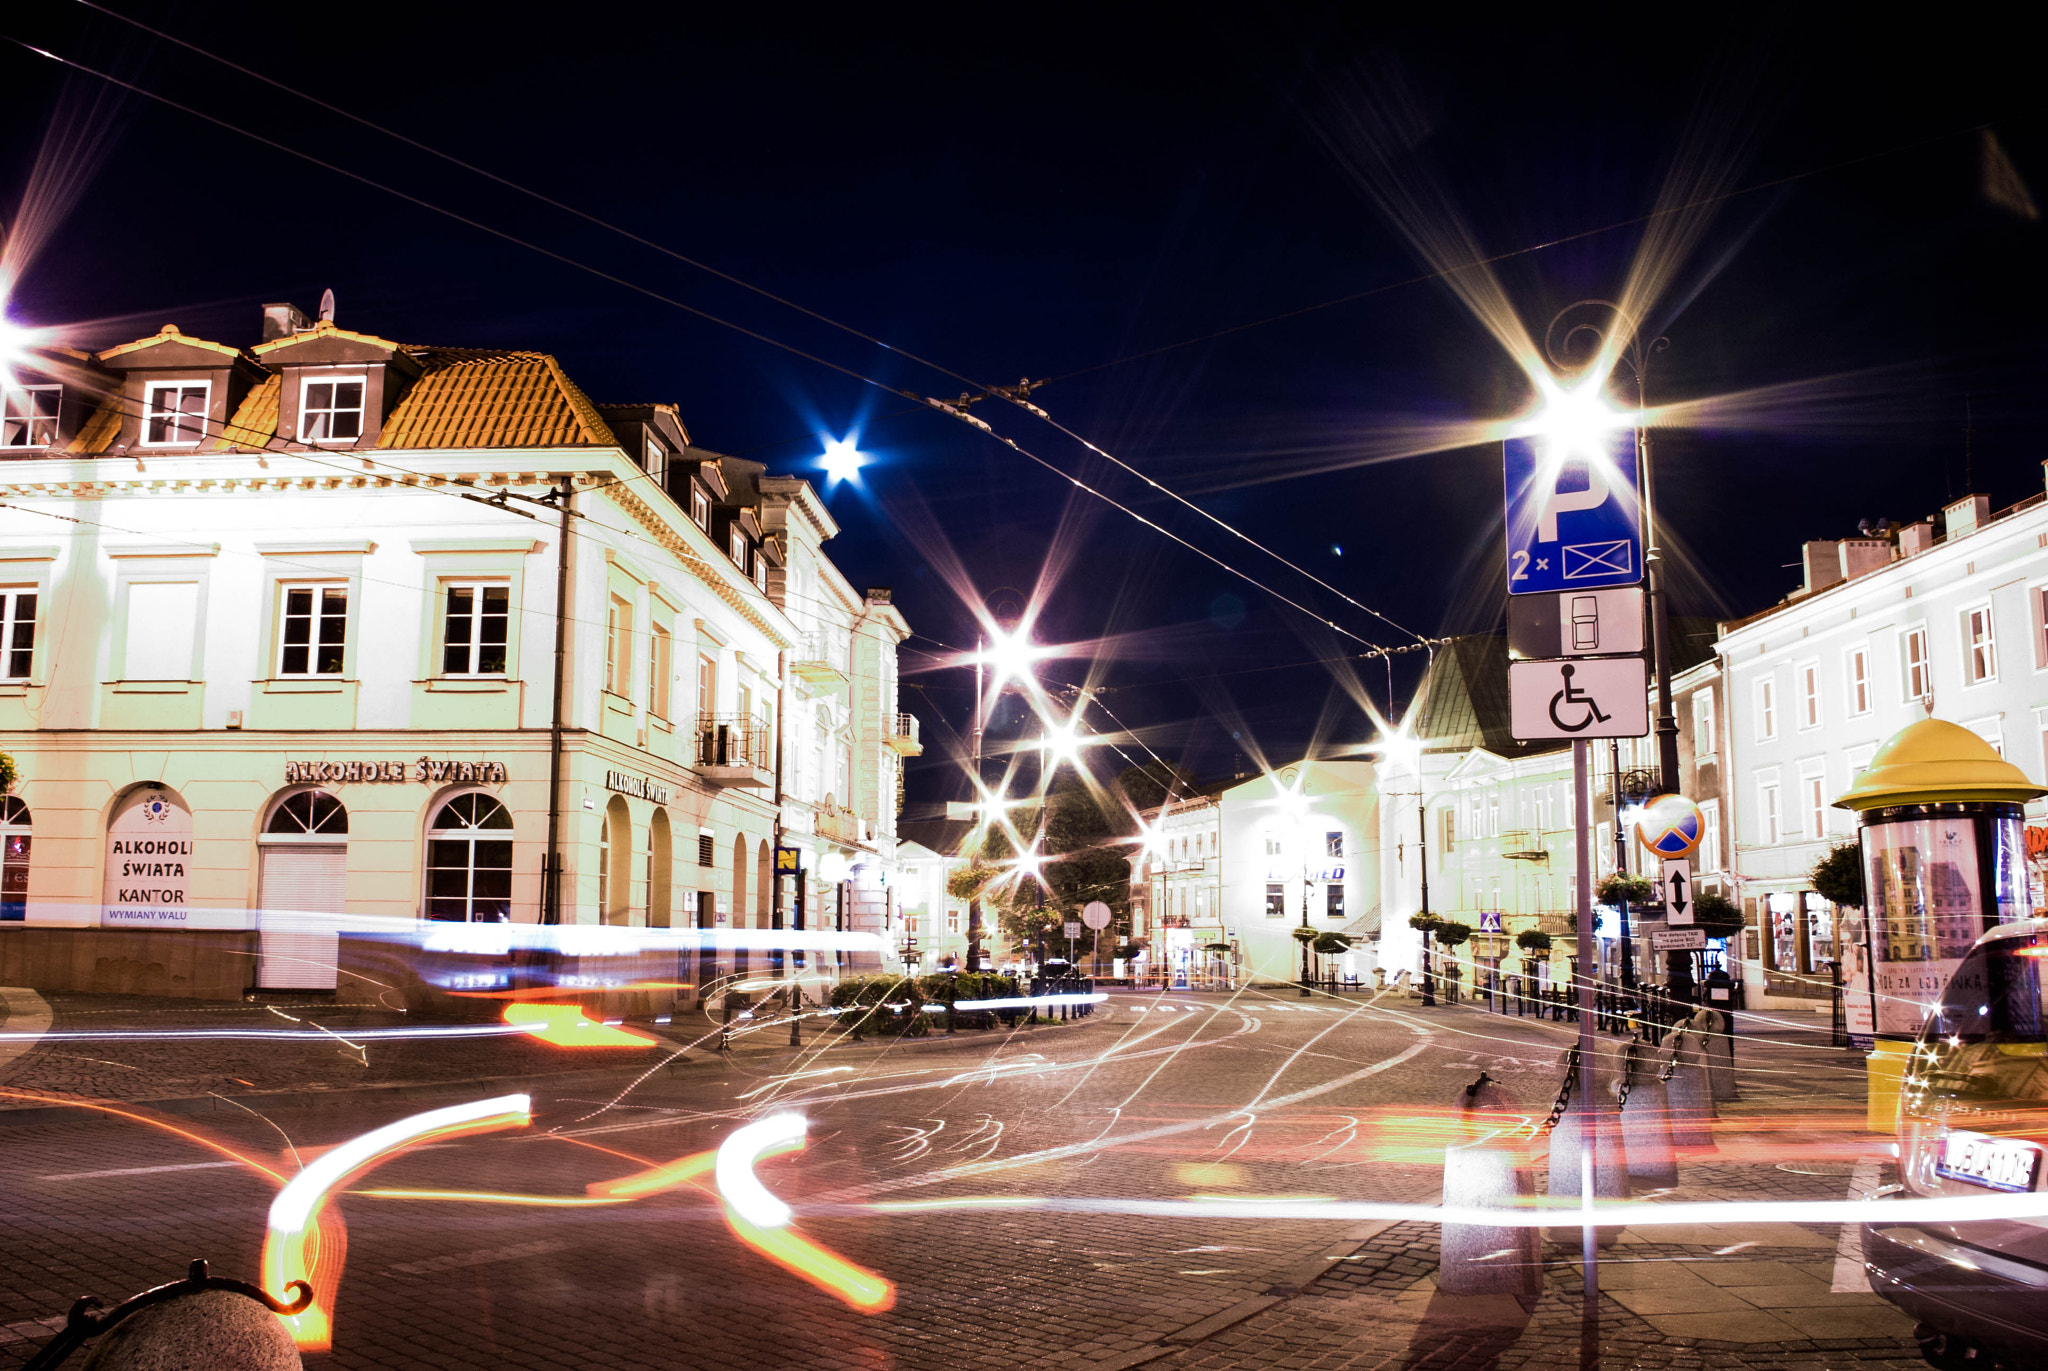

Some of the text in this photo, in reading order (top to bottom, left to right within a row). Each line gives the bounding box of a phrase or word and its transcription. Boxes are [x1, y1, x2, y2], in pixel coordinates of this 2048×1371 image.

[285, 755, 506, 782] ALKOHOLE ŚWIATA
[606, 769, 645, 799] ALKOHOLE
[113, 841, 193, 855] ALKOHOL
[122, 860, 184, 877] ŚWIATA
[119, 889, 184, 903] KANTOR
[109, 910, 156, 920] WYMIANY
